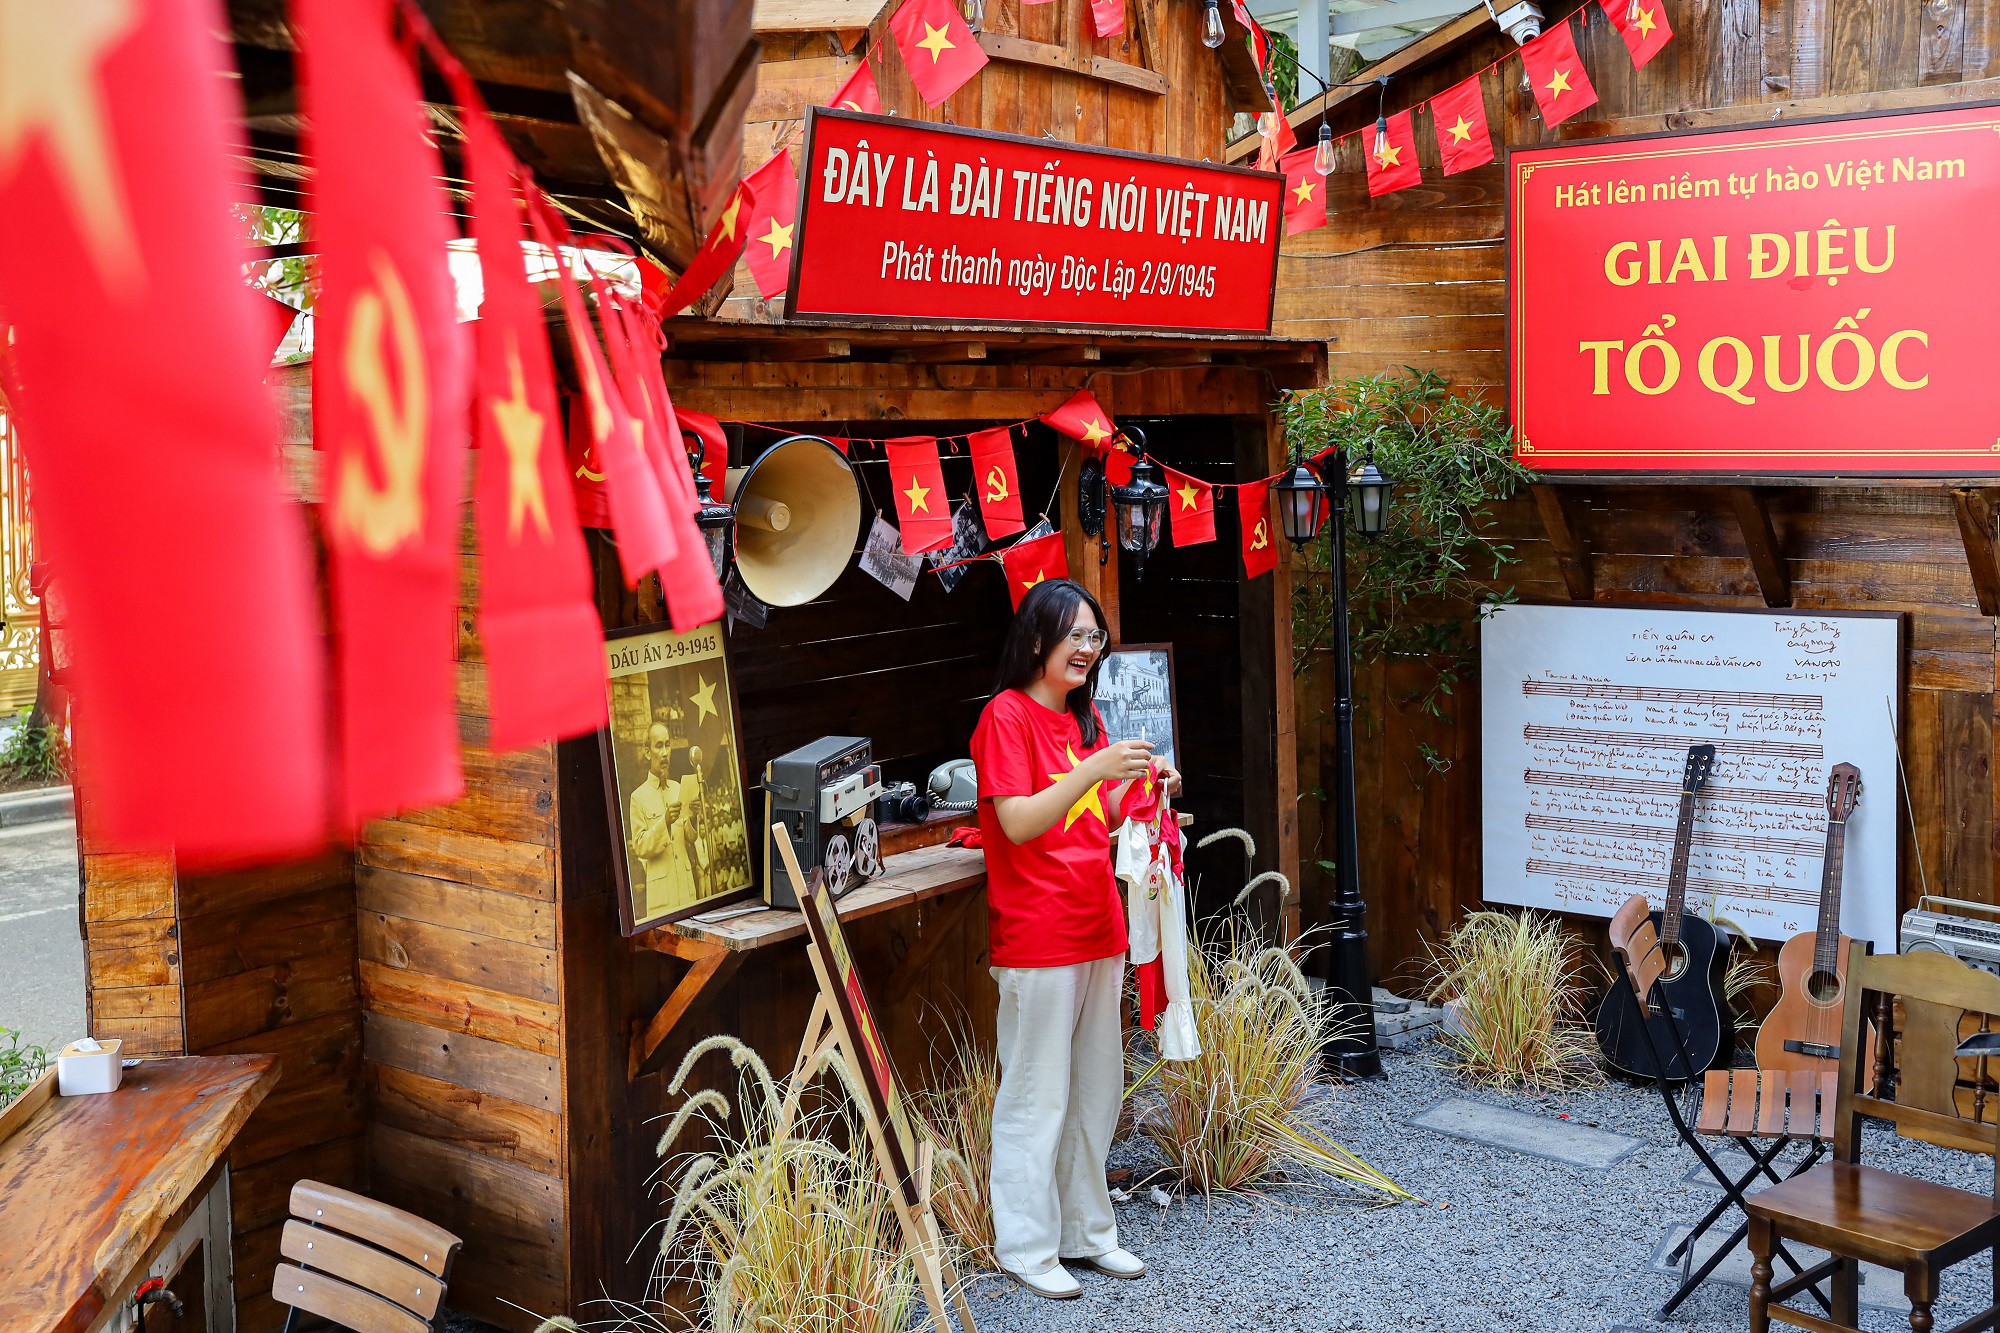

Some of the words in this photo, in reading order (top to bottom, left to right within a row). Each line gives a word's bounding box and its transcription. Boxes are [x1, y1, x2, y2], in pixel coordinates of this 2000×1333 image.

[824, 139, 895, 208] ĐÂY
[902, 150, 939, 213] LÀ
[950, 157, 1003, 219] ĐÀI
[1013, 160, 1091, 228] TIẾNG
[1100, 176, 1145, 233] NÓI
[1156, 182, 1209, 244] VIỆT
[1214, 195, 1269, 244] NAM
[1555, 183, 1600, 208] Hát
[1607, 178, 1646, 204] lên
[1651, 173, 1720, 201] niềm
[1728, 172, 1756, 200] tự
[1766, 167, 1818, 194] hào
[1825, 160, 1886, 191] Việt
[1892, 156, 1965, 183] Nam
[881, 241, 935, 282] Phát
[941, 248, 1000, 286] thanh
[1008, 252, 1056, 297] ngày
[1061, 254, 1097, 298] Độc
[1102, 259, 1135, 300] Lập
[1139, 262, 1216, 300] 2/9/1945
[1604, 235, 1728, 286] GIAI
[1748, 218, 1896, 286] ĐIỆU
[1579, 313, 1680, 396] TỔ
[1698, 307, 1929, 406] QUỐC
[610, 646, 639, 670] DẤU
[643, 643, 663, 662] ẤN
[664, 635, 716, 659] 2-9-1945
[1632, 626, 1658, 641] TIẾN
[1665, 628, 1694, 642] QUÂN
[1700, 633, 1714, 643] CA
